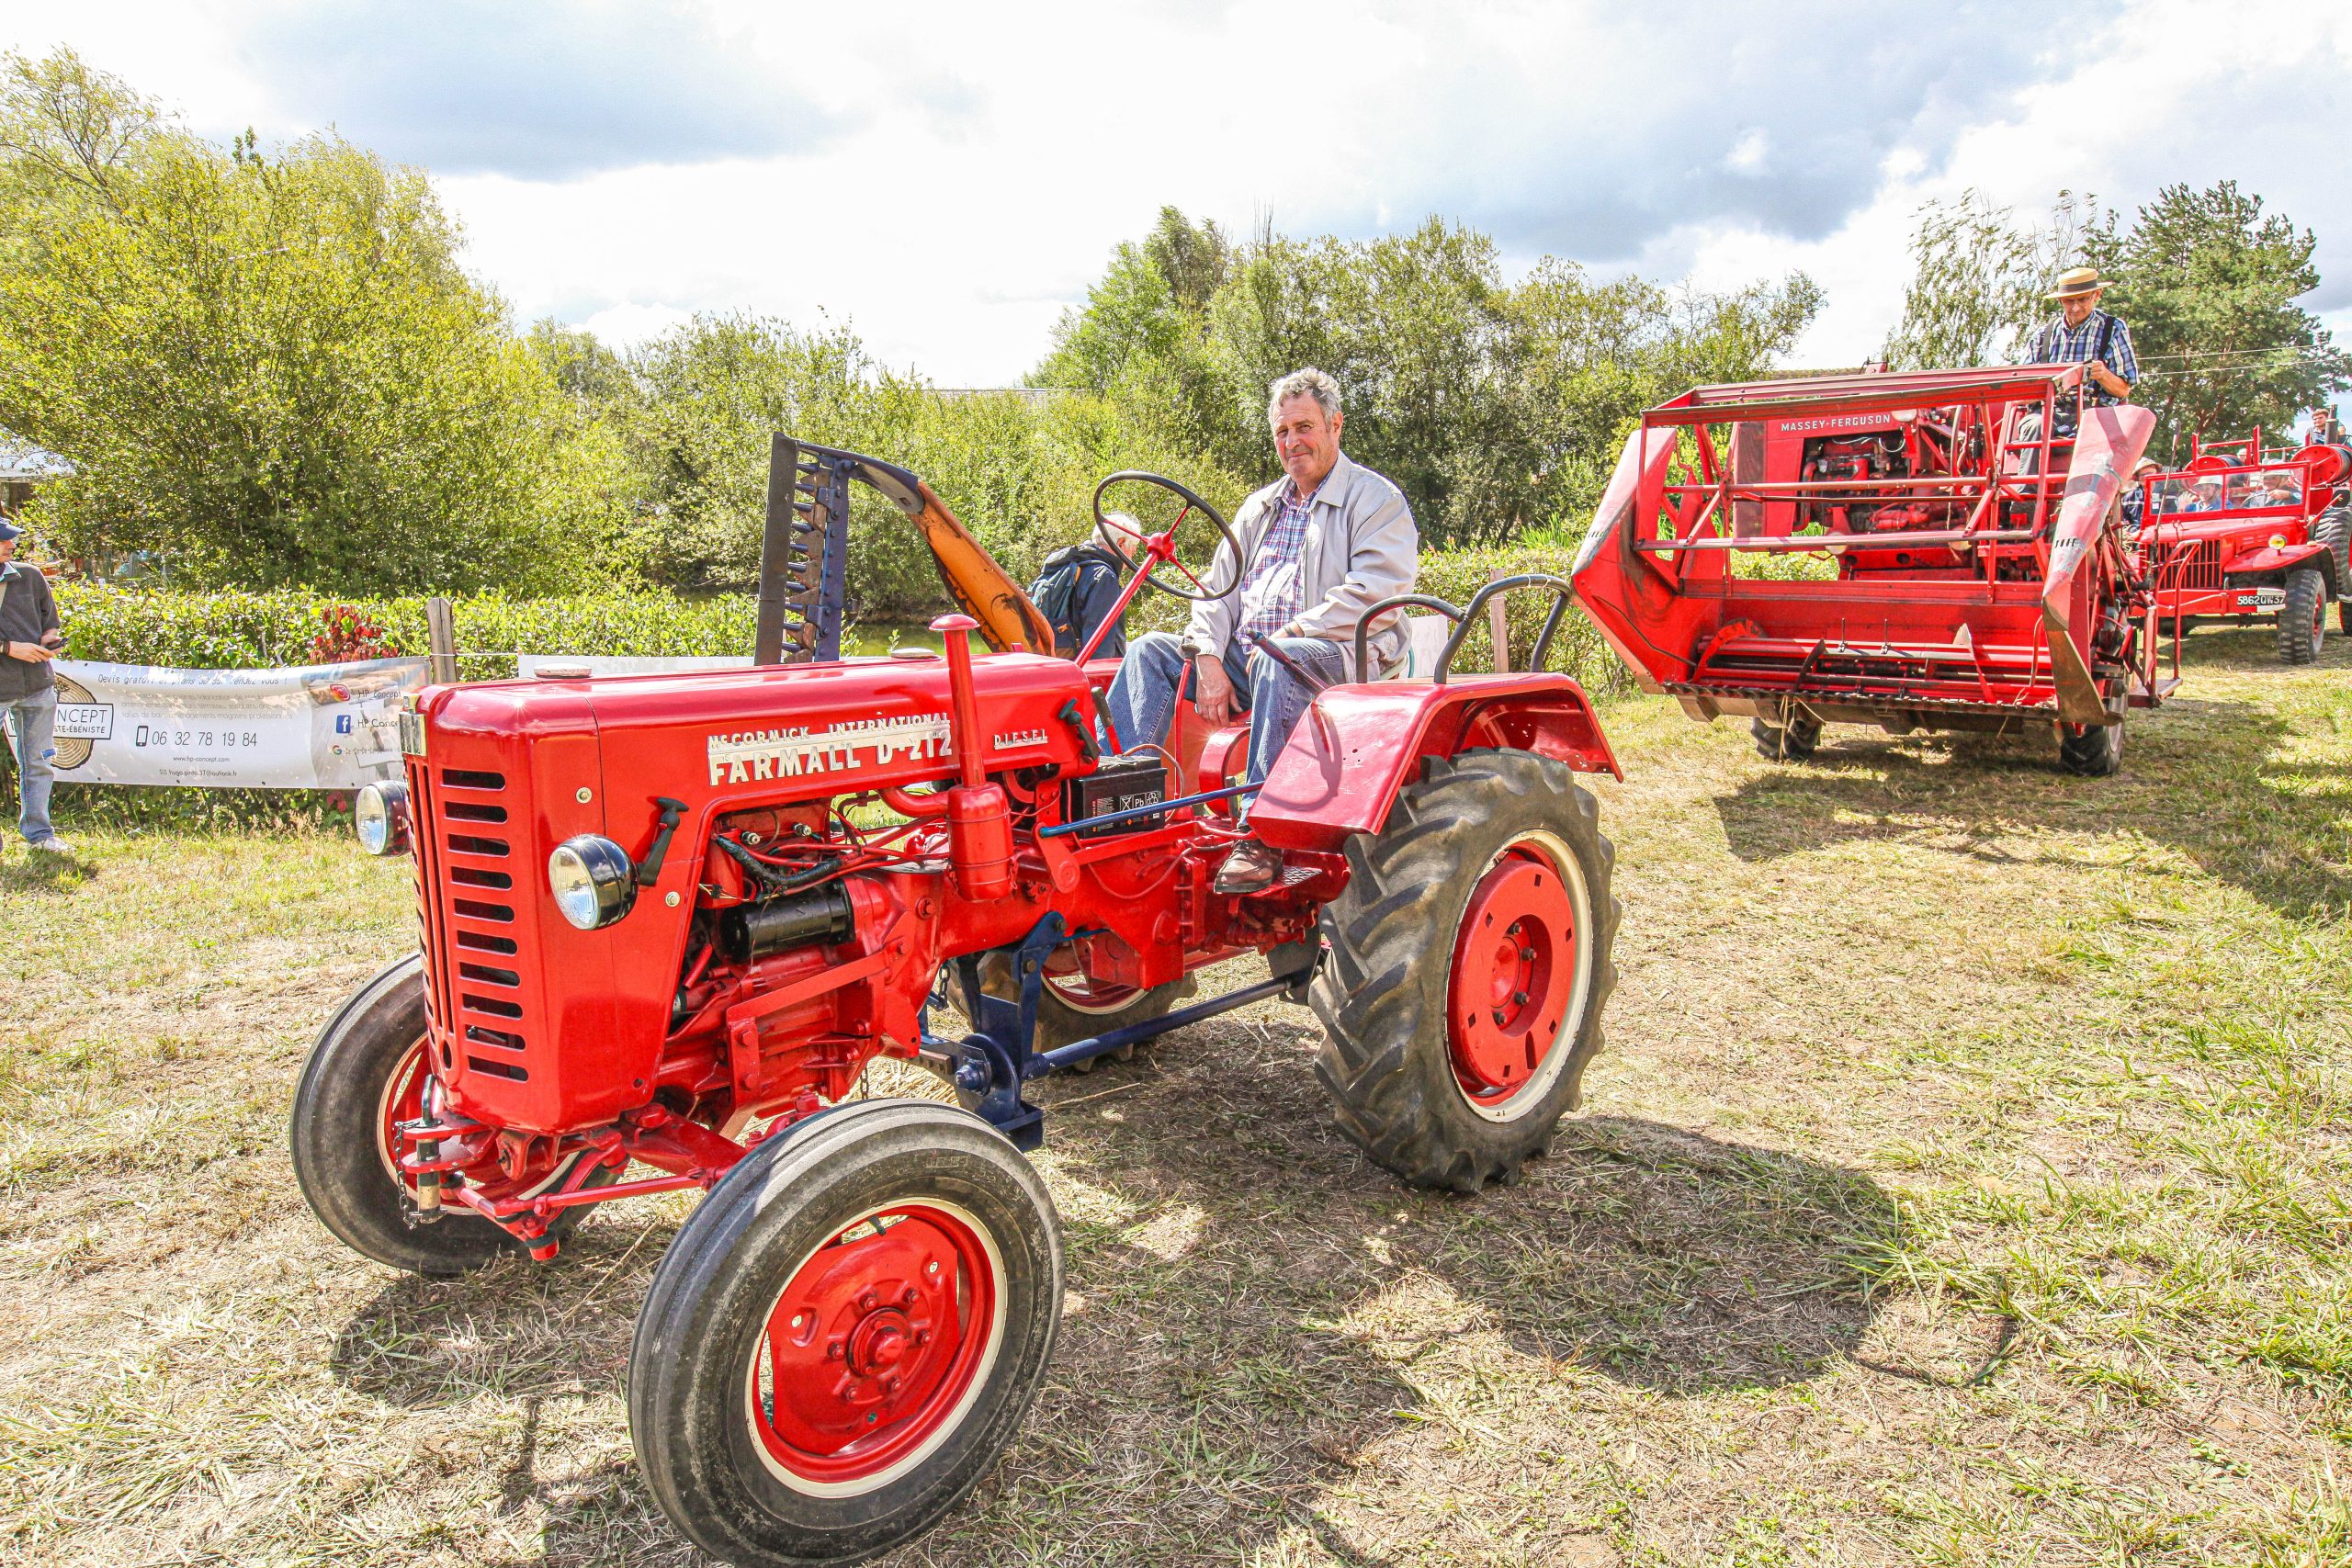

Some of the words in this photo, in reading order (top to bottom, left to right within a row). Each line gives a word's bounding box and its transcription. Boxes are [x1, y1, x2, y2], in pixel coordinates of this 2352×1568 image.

[2237, 595, 2285, 605] 5862QW37
[97, 673, 120, 683] Devis
[58, 709, 107, 724] NCEPT
[357, 719, 368, 728] HP
[371, 718, 399, 728] Conce
[828, 712, 950, 736] INTERNATIONAL
[152, 731, 168, 746] 06
[175, 731, 190, 746] 32
[198, 731, 213, 746] 78
[222, 732, 235, 747] 19
[242, 732, 257, 747] 84
[994, 728, 1048, 748] DIESEL
[172, 755, 231, 763] www.hp-concept.com
[709, 744, 861, 786] FARMALL
[1135, 797, 1145, 807] Pb
